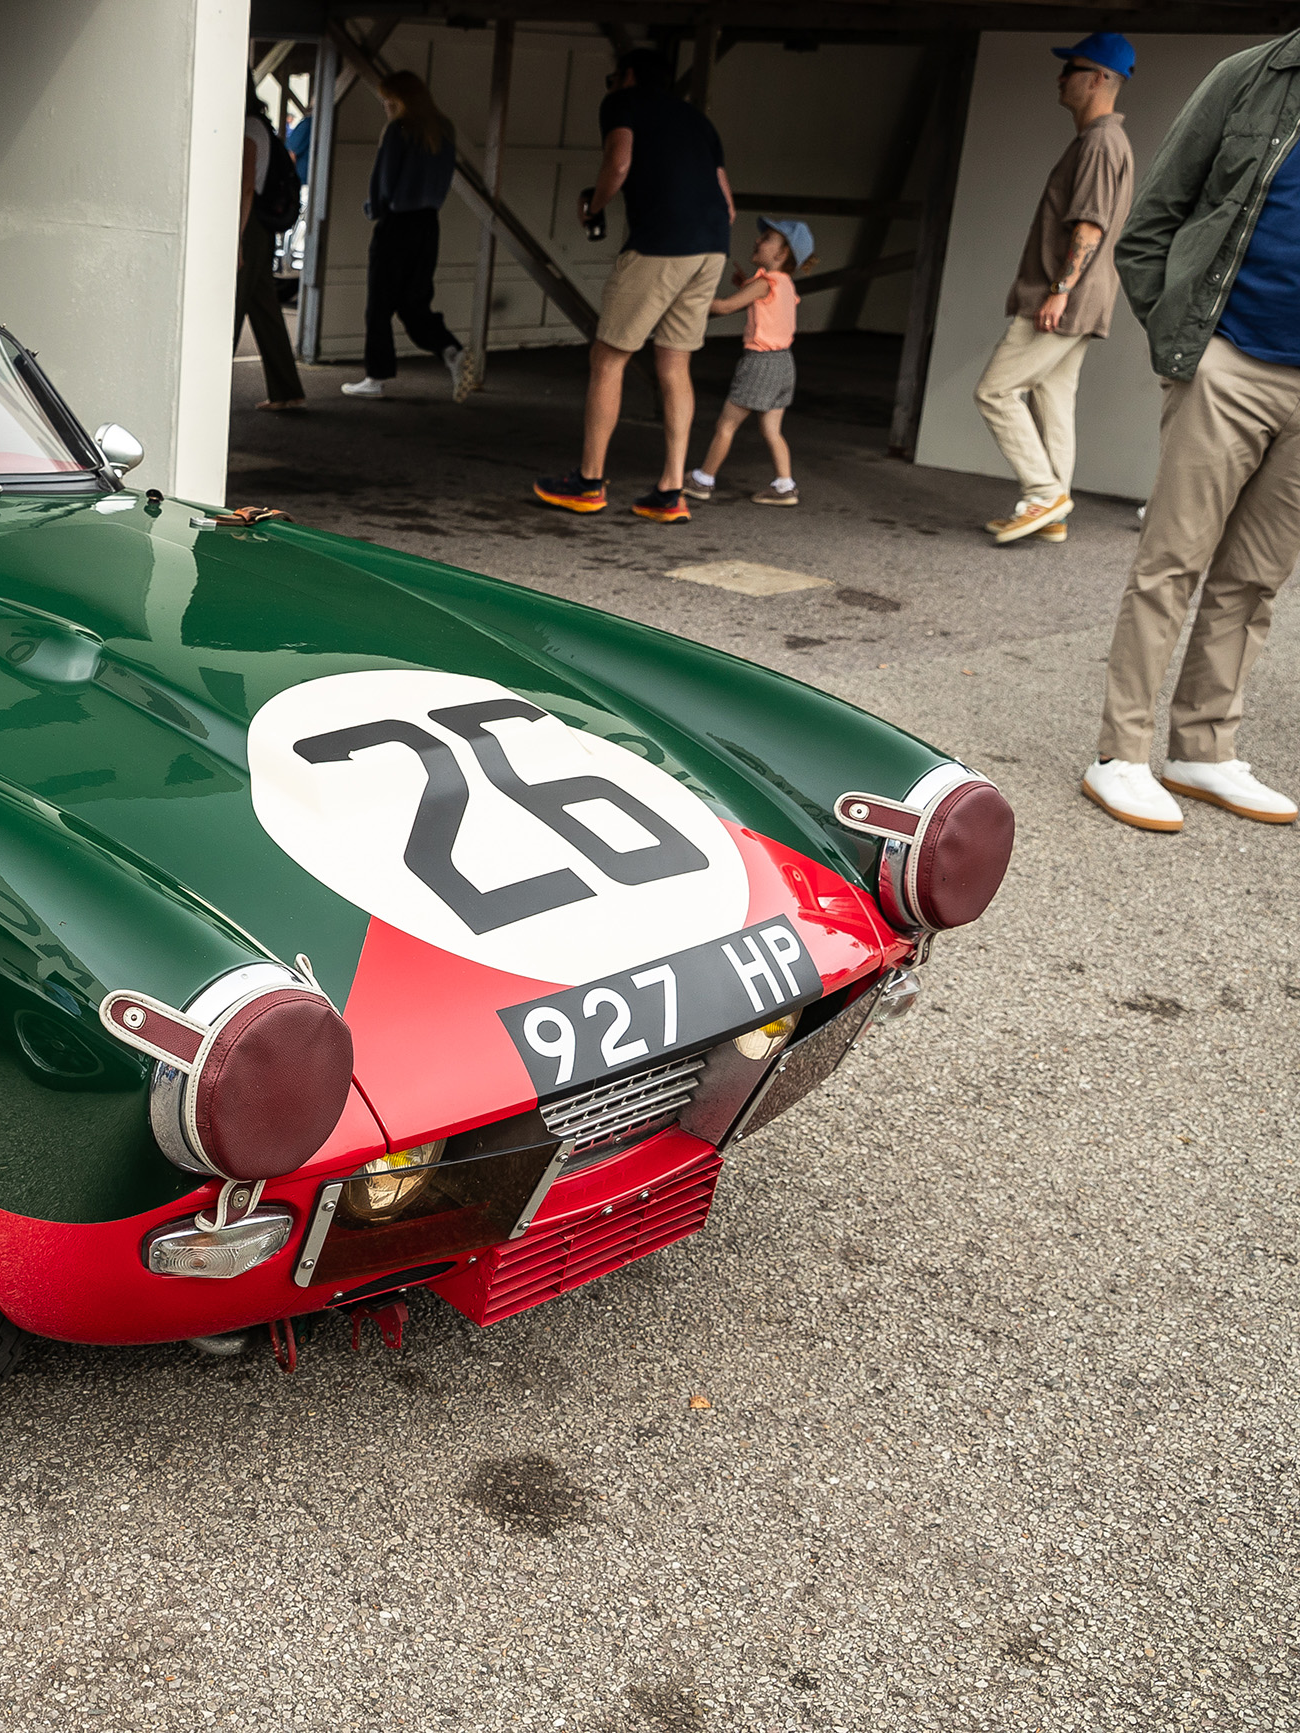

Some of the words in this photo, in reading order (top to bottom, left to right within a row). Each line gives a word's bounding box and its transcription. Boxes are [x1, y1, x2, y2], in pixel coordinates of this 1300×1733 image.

[293, 698, 709, 935] 26
[523, 963, 678, 1086] 927
[720, 923, 801, 1014] HP
